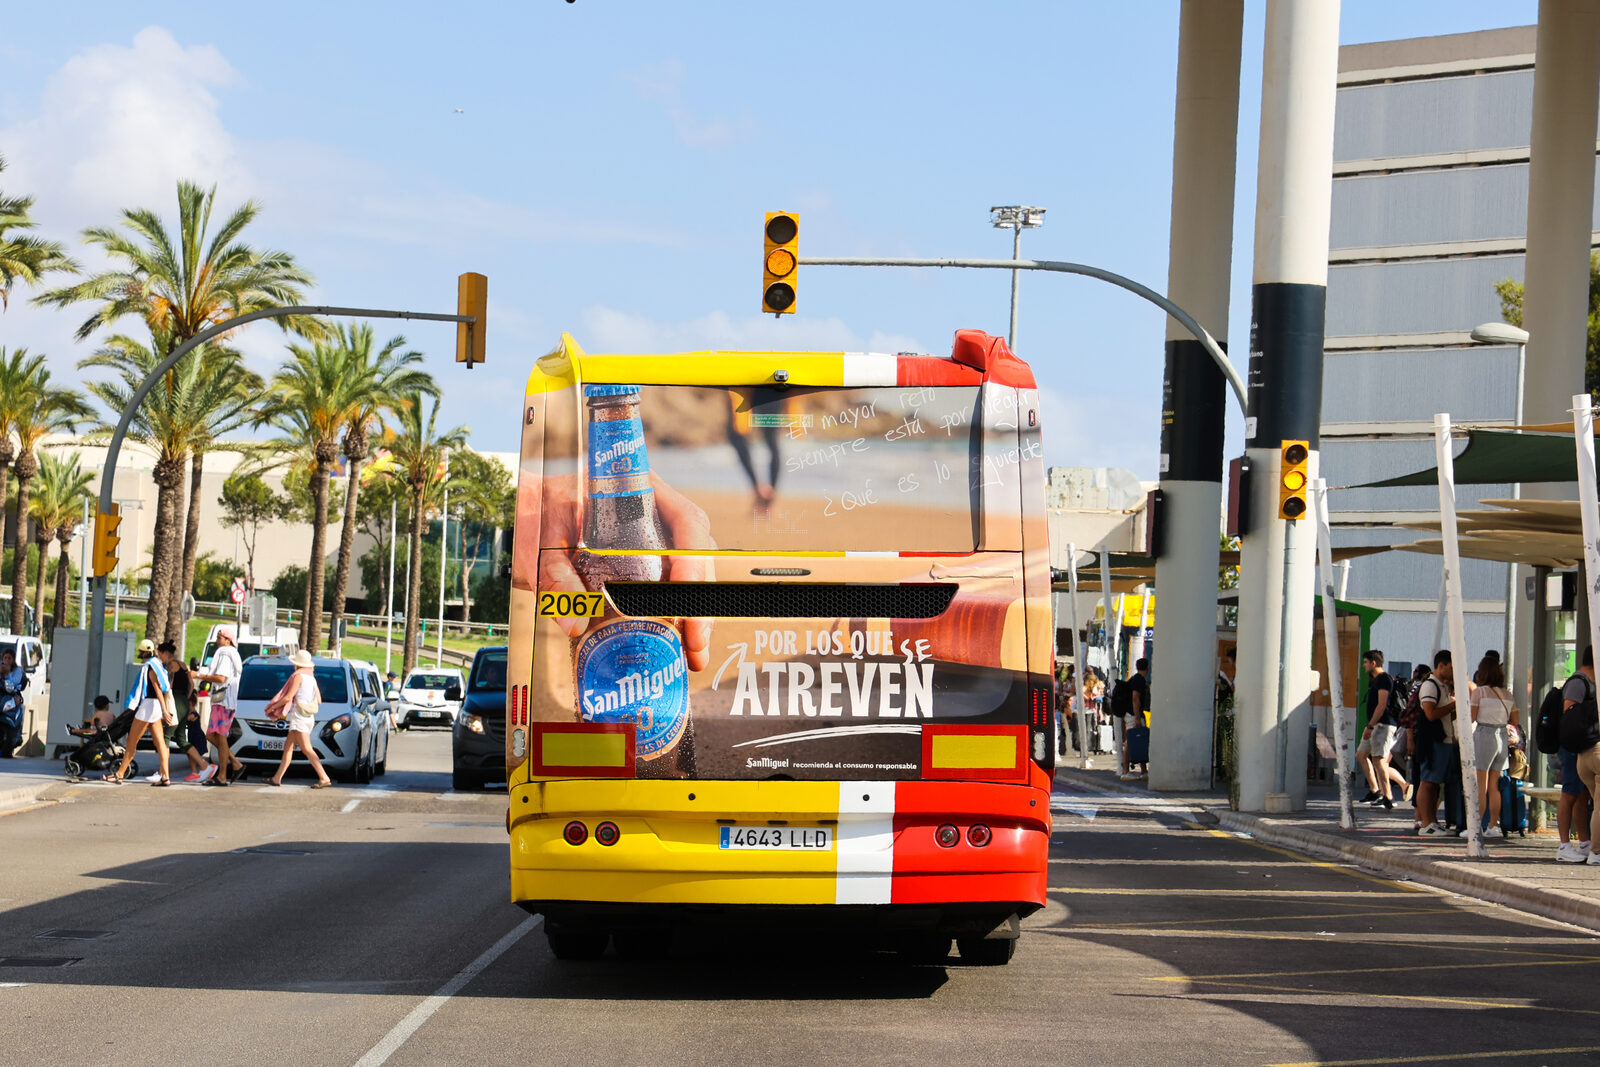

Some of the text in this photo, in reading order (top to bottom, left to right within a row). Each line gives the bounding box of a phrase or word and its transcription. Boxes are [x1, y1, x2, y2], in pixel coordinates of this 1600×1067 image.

[821, 400, 877, 429] mayor
[900, 386, 936, 409] reto
[785, 437, 871, 473] siempre
[885, 408, 926, 441] está
[939, 406, 969, 437] por
[823, 479, 880, 518] ¿Qué
[897, 473, 920, 493] es
[934, 460, 950, 485] lo
[540, 594, 603, 616] 2067
[588, 638, 600, 648] DE
[755, 629, 933, 666] POR LOS QUE SE
[729, 661, 935, 718] ATREVEN
[793, 761, 834, 769] recomienda
[875, 762, 917, 771] responsable
[734, 829, 827, 848] 4643 LLD
